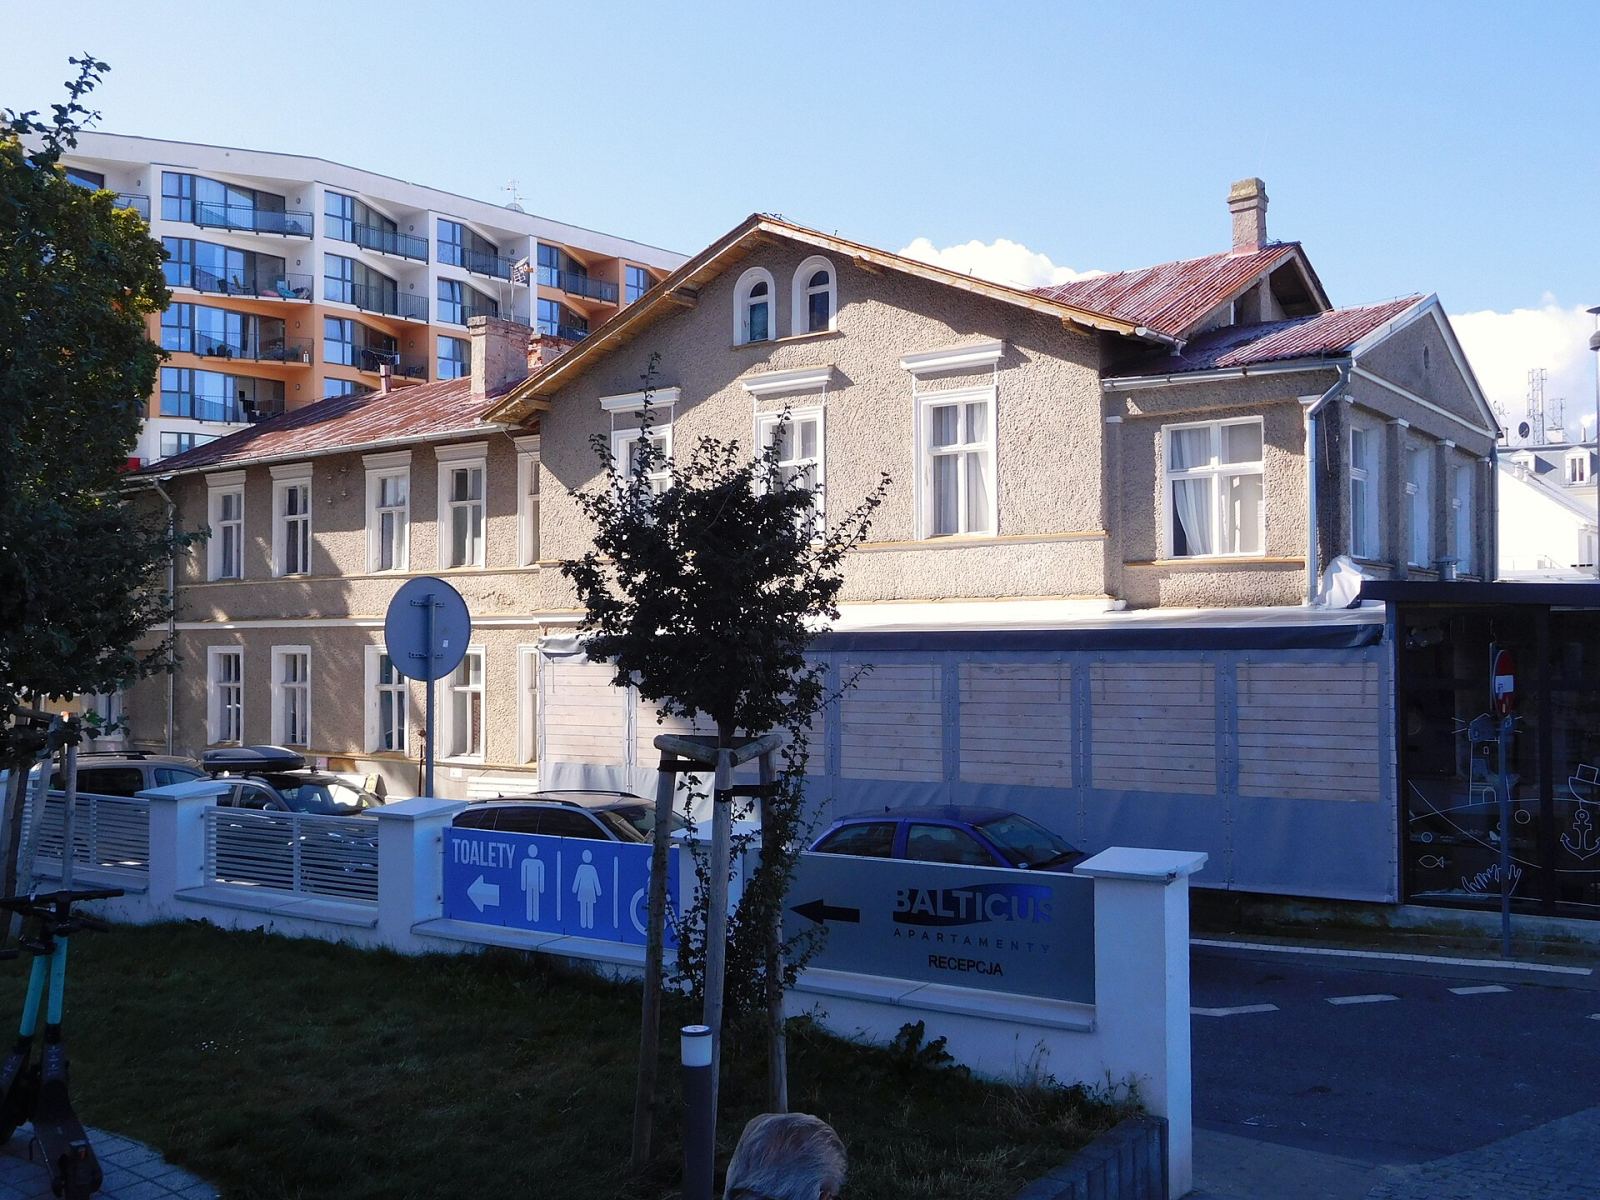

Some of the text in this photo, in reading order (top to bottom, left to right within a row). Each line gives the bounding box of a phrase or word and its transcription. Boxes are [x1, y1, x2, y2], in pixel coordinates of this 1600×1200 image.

[452, 838, 516, 869] TOALETY
[893, 888, 1053, 923] BALTICUS
[893, 927, 1050, 953] APARTAMENTY
[928, 954, 1004, 976] RECEPCJA
